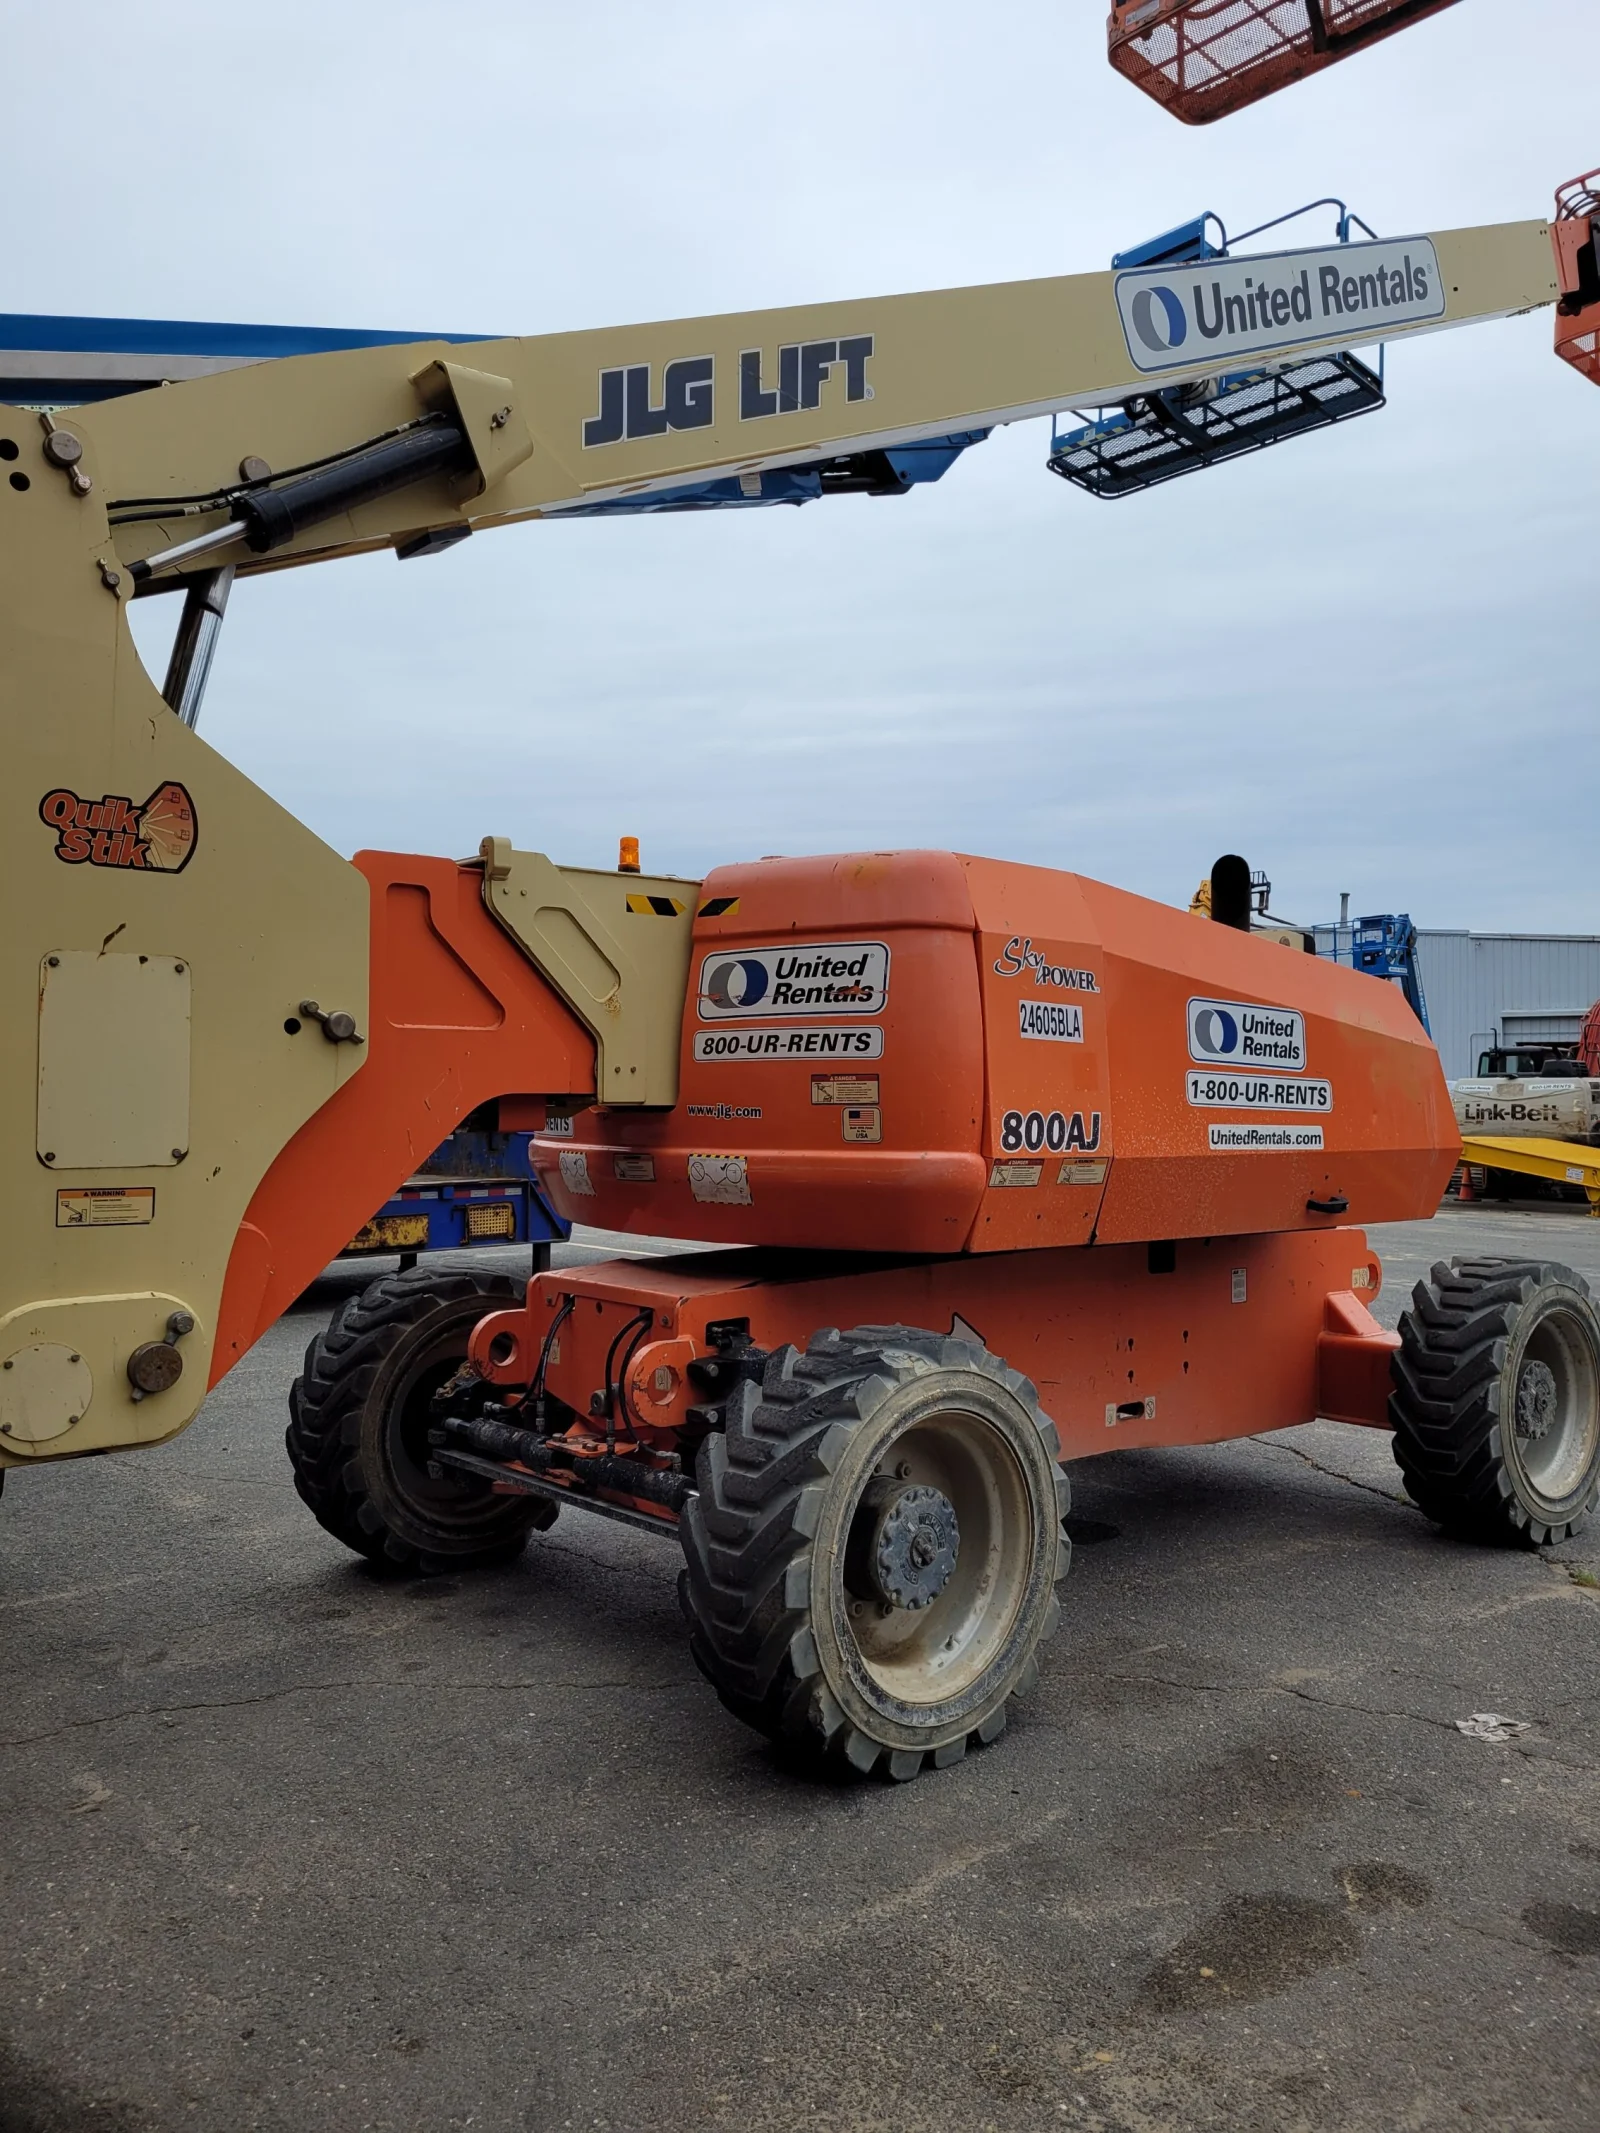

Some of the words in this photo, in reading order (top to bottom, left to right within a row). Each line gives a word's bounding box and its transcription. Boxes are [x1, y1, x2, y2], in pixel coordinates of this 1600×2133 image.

[1193, 269, 1312, 339] United
[1318, 255, 1429, 317] Rentals
[582, 354, 715, 449] JLG
[739, 333, 874, 422] LIFT
[43, 792, 142, 833] Quik
[58, 828, 150, 867] Stik
[775, 954, 869, 980] United
[994, 937, 1045, 985] Sky
[1041, 965, 1096, 991] POWER
[771, 980, 874, 1005] Rentals
[1020, 1003, 1081, 1038] 24605BLA
[1242, 1013, 1294, 1037] United
[702, 1032, 872, 1055] 800-UR-RENTS
[1242, 1035, 1300, 1060] Rentals
[1191, 1079, 1327, 1106] 1-800-UR-RENTS
[687, 1103, 762, 1120] www.jlg.com
[1001, 1111, 1101, 1153] 800AJ
[1211, 1129, 1322, 1146] UnitedRentals.com
